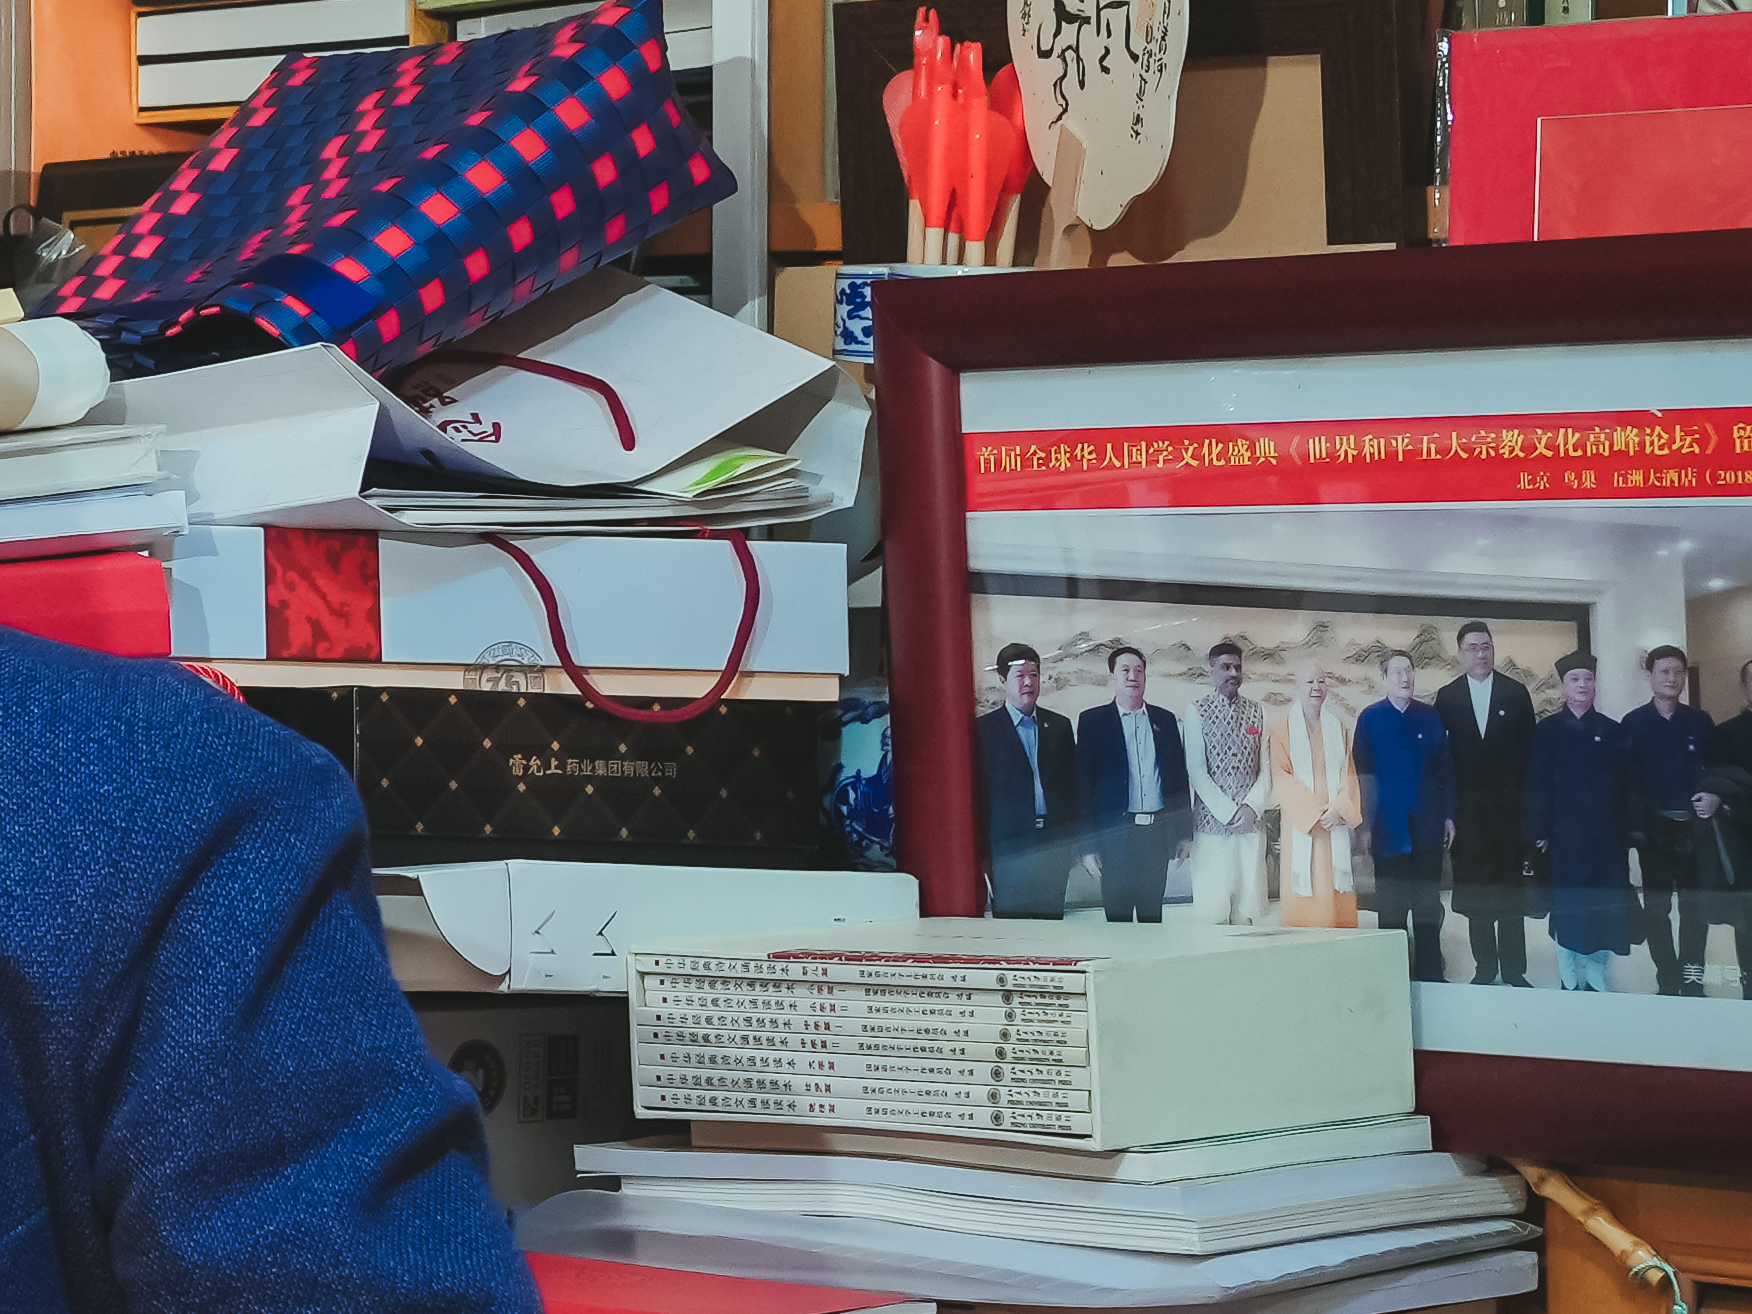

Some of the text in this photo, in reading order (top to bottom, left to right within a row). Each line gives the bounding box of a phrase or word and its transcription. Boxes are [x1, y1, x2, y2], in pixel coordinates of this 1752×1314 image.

[1517, 470, 1551, 492] 北京
[508, 753, 677, 778] 雷允上药业集团有限公司
